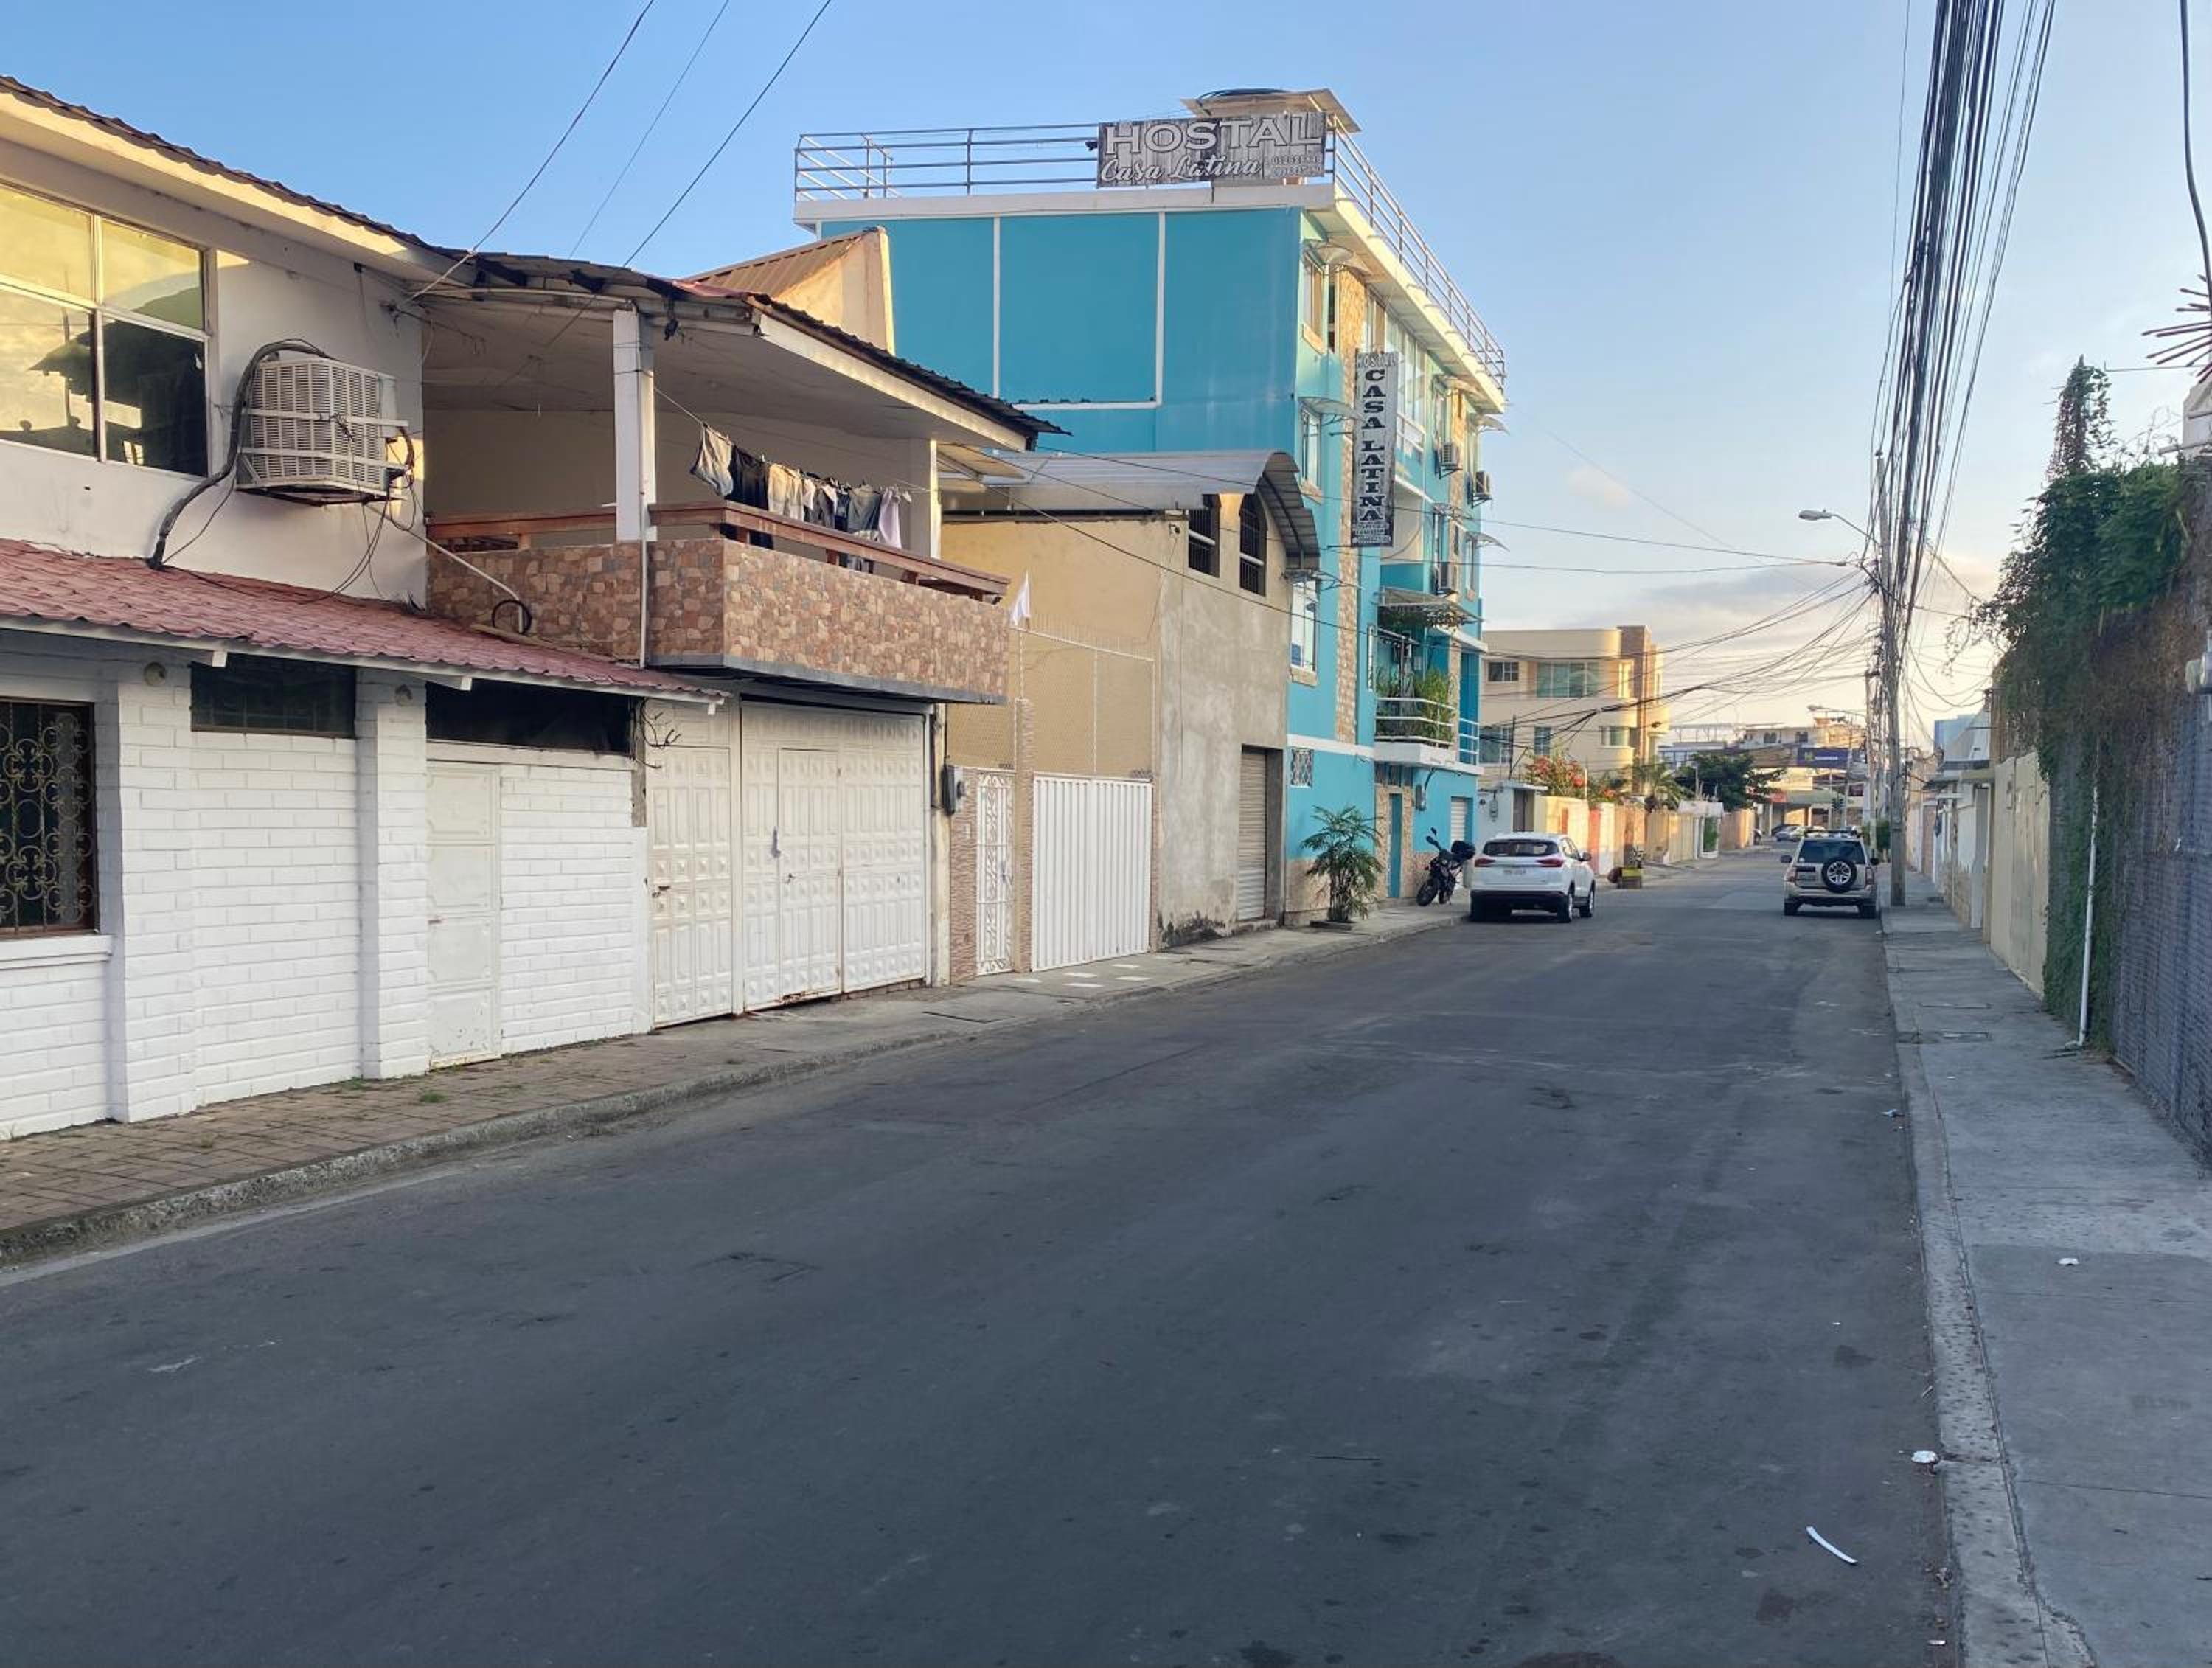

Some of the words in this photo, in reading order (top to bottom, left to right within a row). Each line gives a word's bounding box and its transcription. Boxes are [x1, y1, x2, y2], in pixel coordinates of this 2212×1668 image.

[1105, 116, 1322, 155] HOSTAL
[1099, 158, 1162, 182] Casa
[1169, 153, 1264, 181] Latina
[1361, 369, 1386, 429] CASA
[1360, 440, 1385, 521] LATINA
